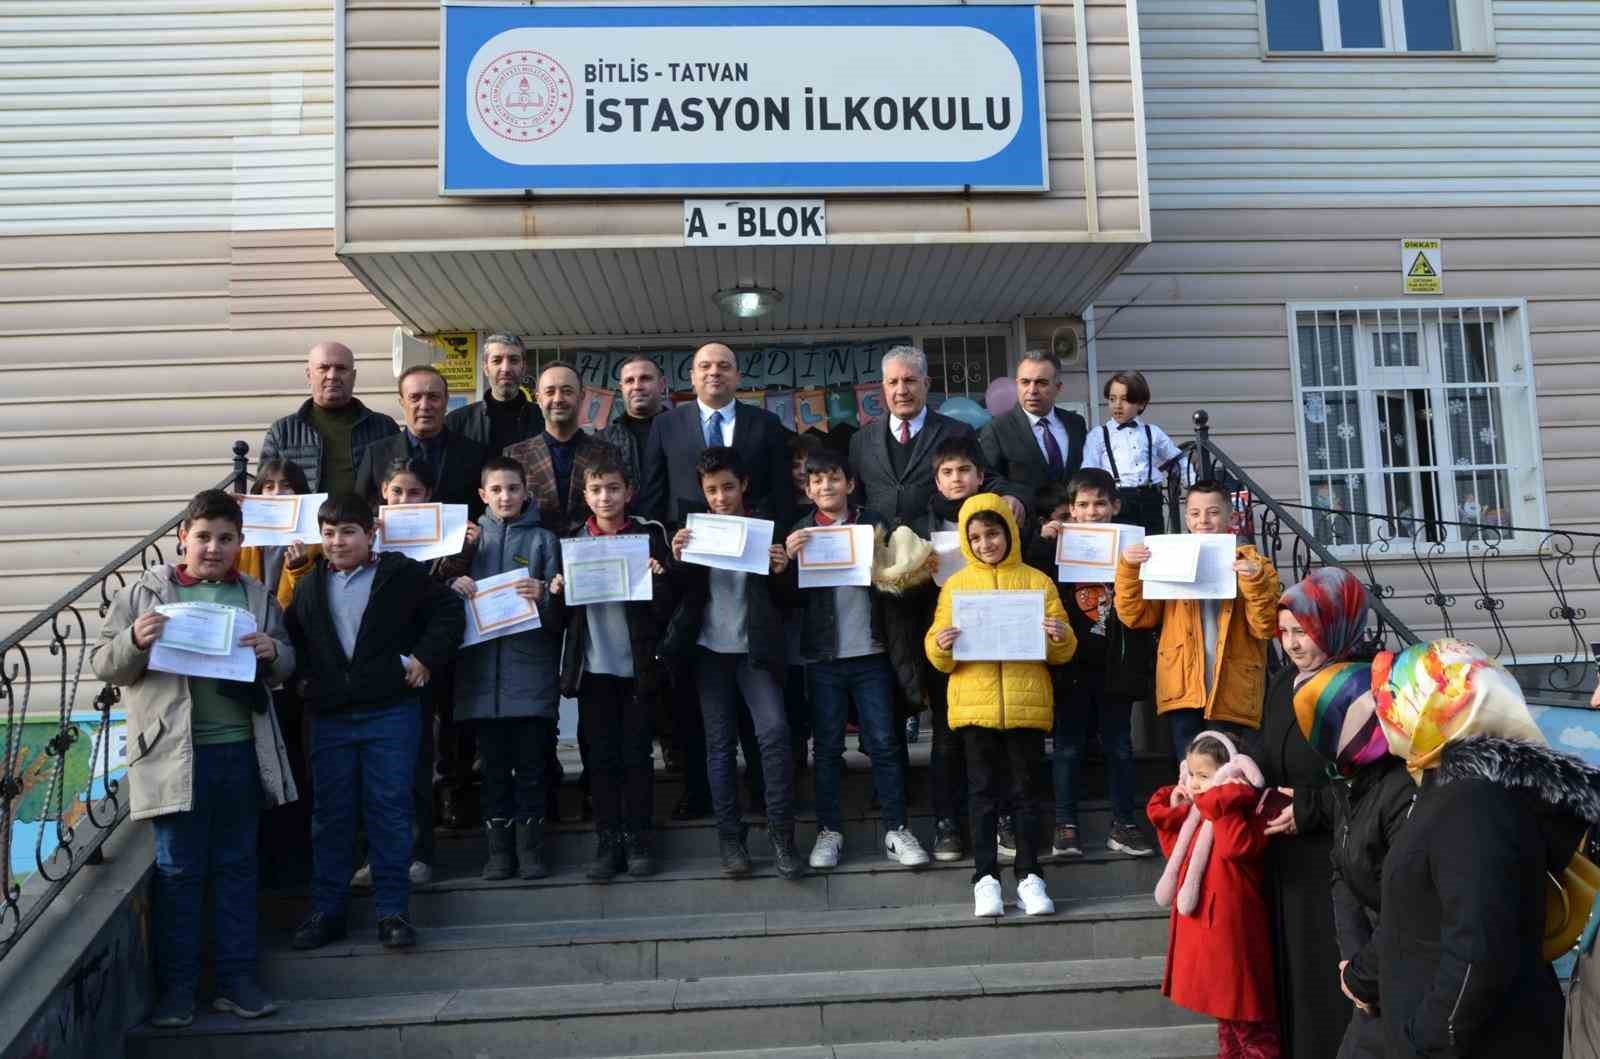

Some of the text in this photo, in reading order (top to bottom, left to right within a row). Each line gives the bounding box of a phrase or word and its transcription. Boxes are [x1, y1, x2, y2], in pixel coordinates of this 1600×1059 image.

[585, 59, 648, 82] BİTLİS
[669, 62, 748, 82] TATVAN
[585, 88, 790, 133] İSTASYON
[804, 87, 1011, 132] İLKOKULU
[687, 207, 708, 238] A
[738, 206, 822, 237] BLOK
